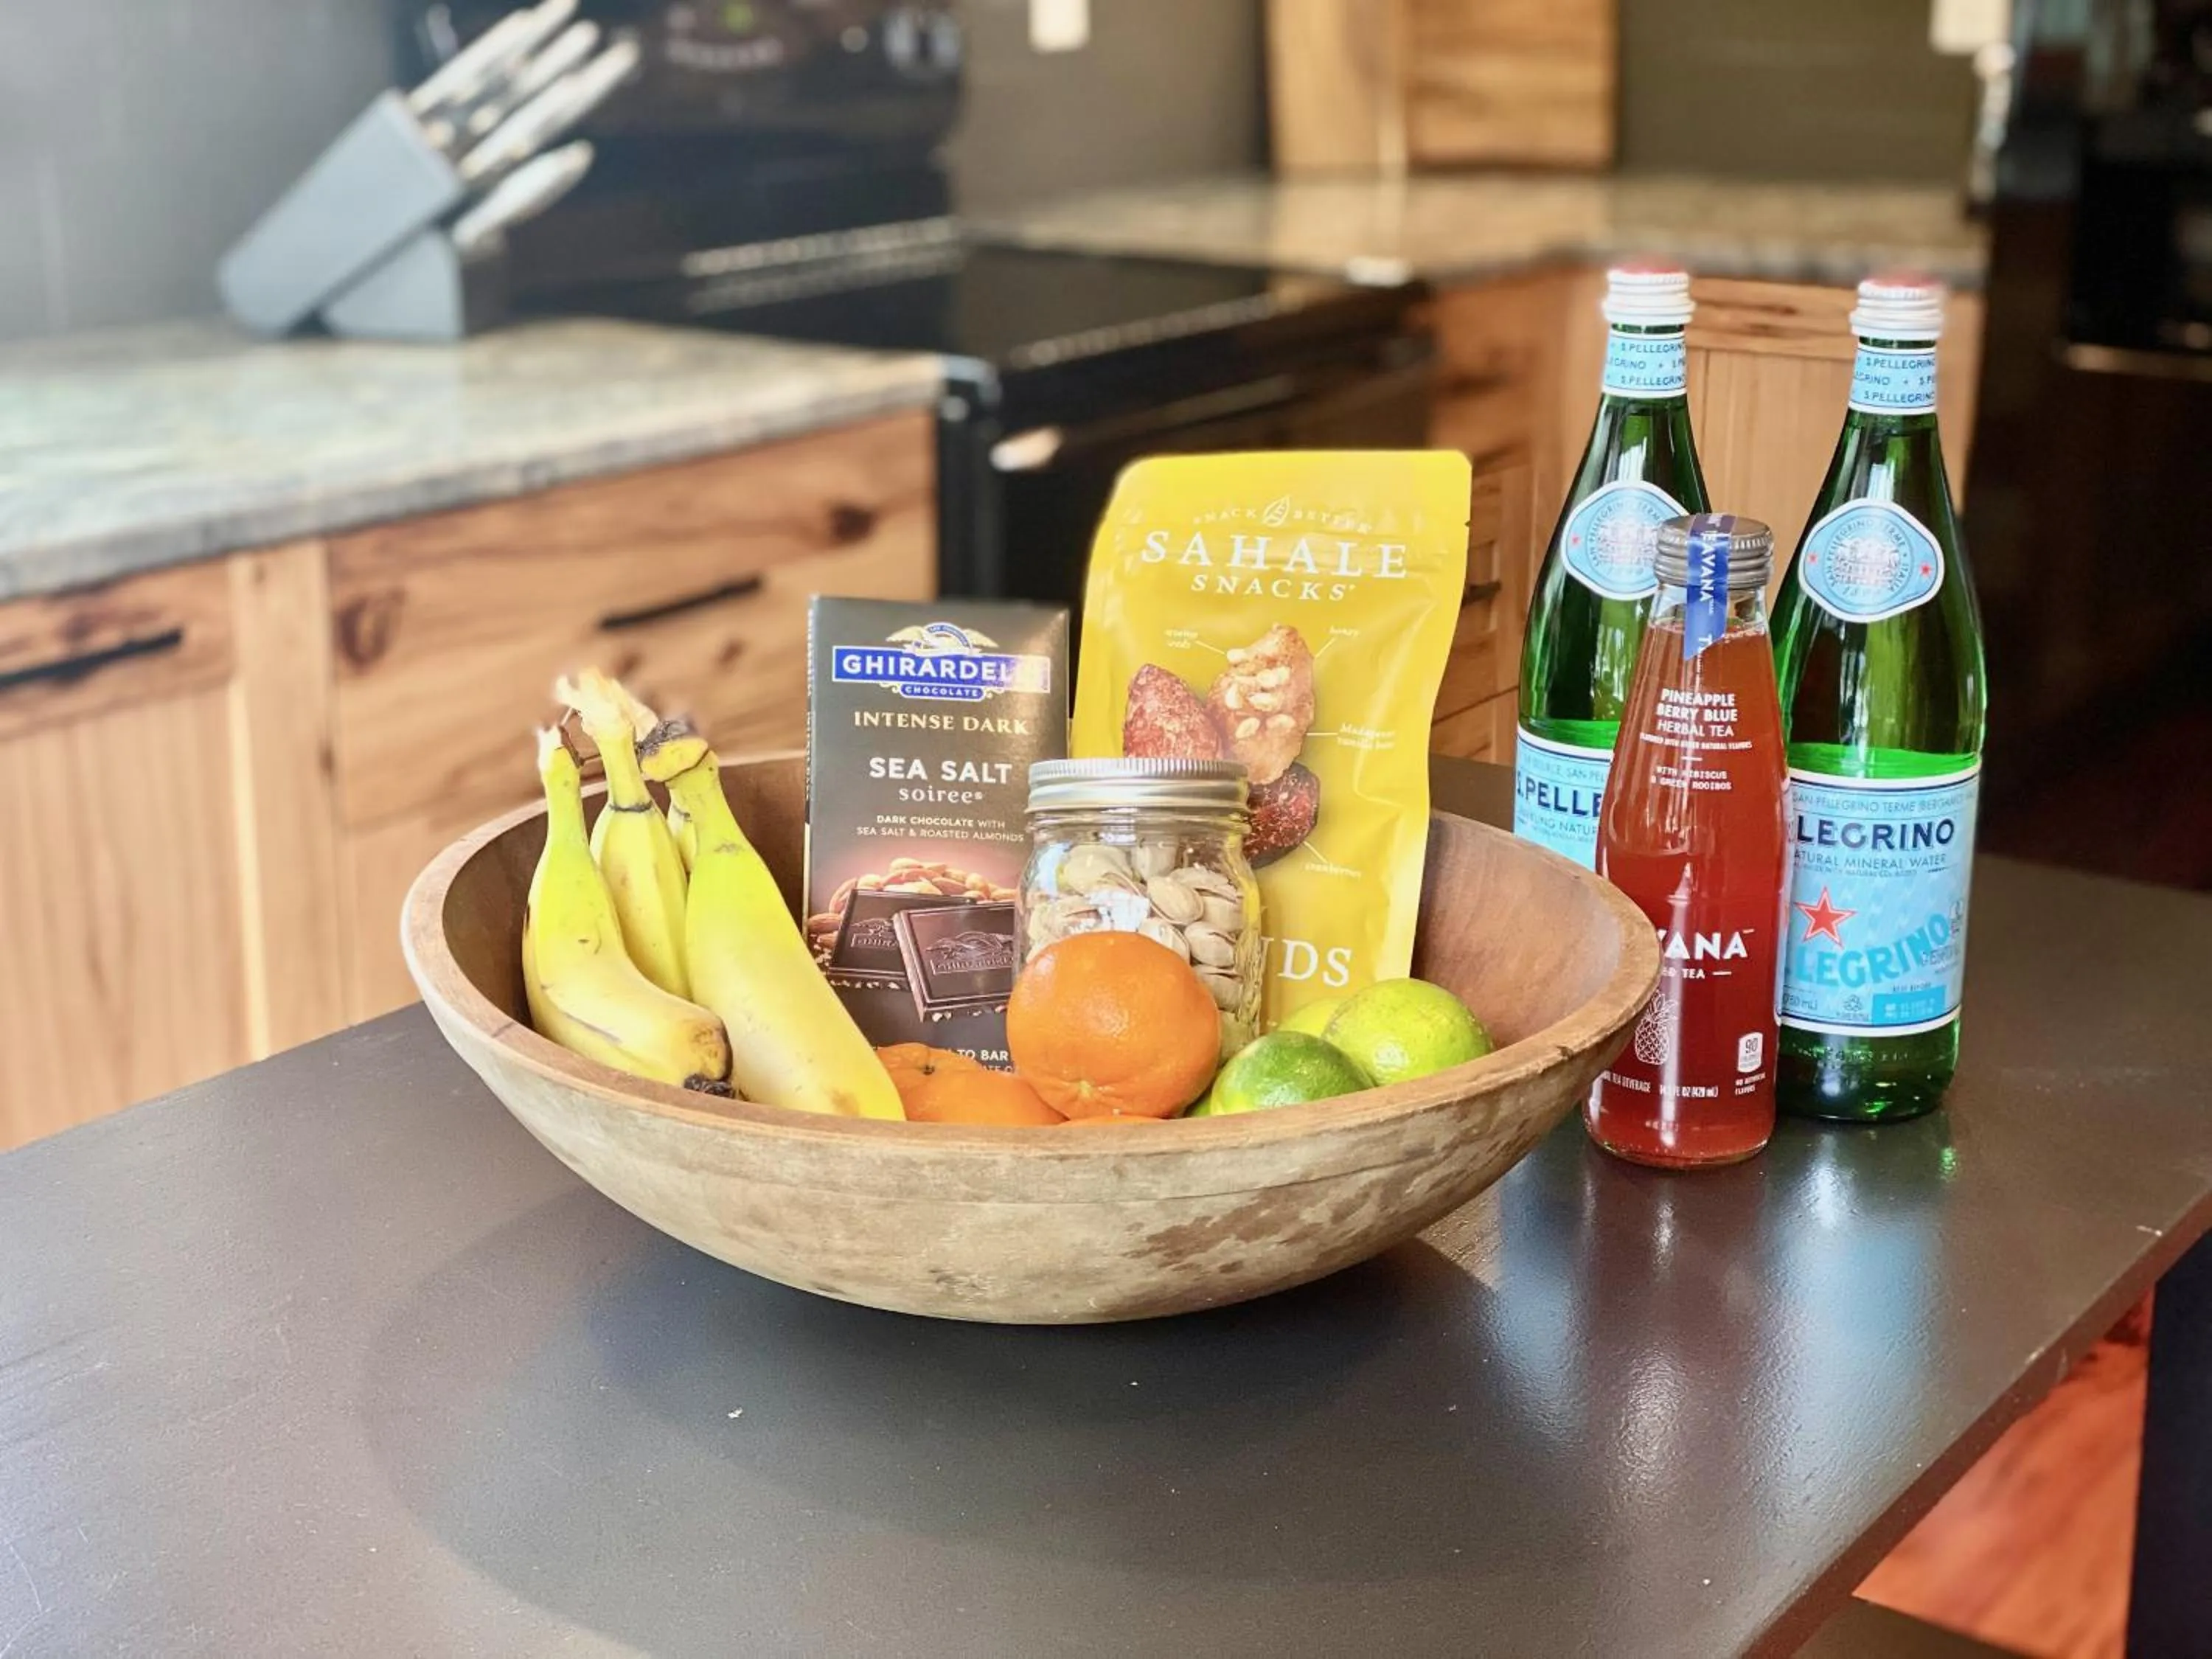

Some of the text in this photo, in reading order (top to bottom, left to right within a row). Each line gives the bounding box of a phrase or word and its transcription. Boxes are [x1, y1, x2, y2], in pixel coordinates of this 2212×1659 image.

[1141, 530, 1408, 579] SAHALE
[1191, 573, 1349, 601] SNACKS
[842, 654, 1036, 684] GHIRARDEL
[905, 686, 979, 698] CHOCOLATE
[1661, 688, 1735, 706] PINEAPPLE
[1656, 703, 1738, 722] BERRY BLUE
[854, 711, 1029, 735] INTENSE DARK
[1657, 720, 1734, 737] HERBAL TEA
[869, 757, 1013, 785] SEA SALT
[1657, 766, 1727, 779] WITH HIBISCUS
[1692, 782, 1732, 790] ROOIBOS
[1883, 801, 1916, 813] TERME
[877, 815, 1005, 829] DARK CHOCOLATE WITH
[856, 827, 876, 835] SEA
[881, 827, 904, 836] SALT
[920, 829, 968, 839] ROASTED
[973, 831, 1024, 842] ALMONDS
[1797, 815, 1955, 849] LEGRINO
[1844, 857, 1903, 870] MINERAL
[1910, 853, 1947, 867] WATER
[1682, 968, 1705, 979] TEA
[1745, 1037, 1759, 1054] 90
[981, 1049, 1009, 1062] BAR
